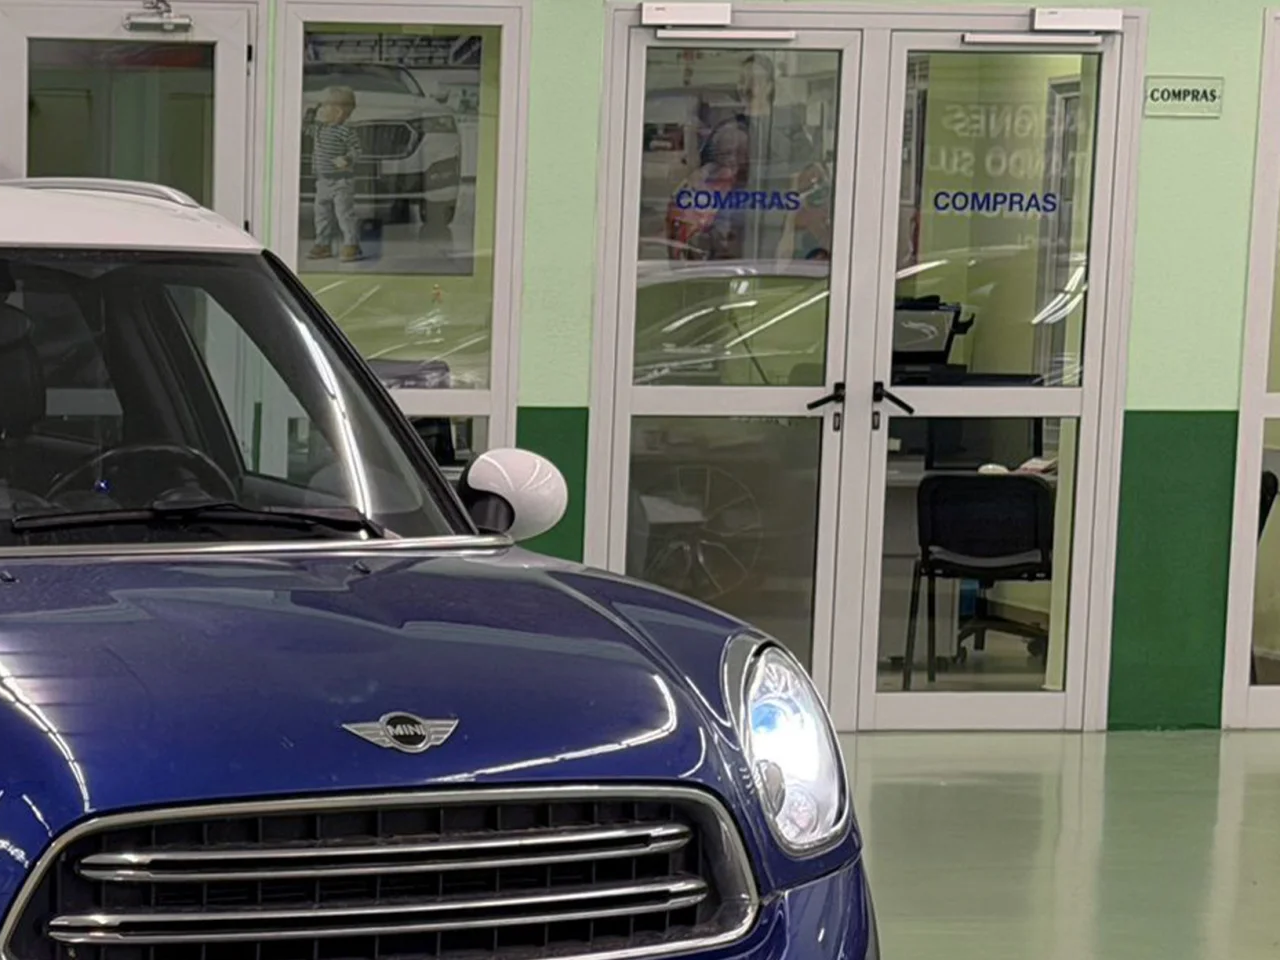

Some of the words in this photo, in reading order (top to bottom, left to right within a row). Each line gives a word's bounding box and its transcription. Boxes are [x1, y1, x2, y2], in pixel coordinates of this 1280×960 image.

[1149, 88, 1217, 102] COMPRAS
[676, 190, 801, 210] COMPRAS
[934, 191, 1057, 212] COMPRAS
[386, 724, 426, 736] MINI
